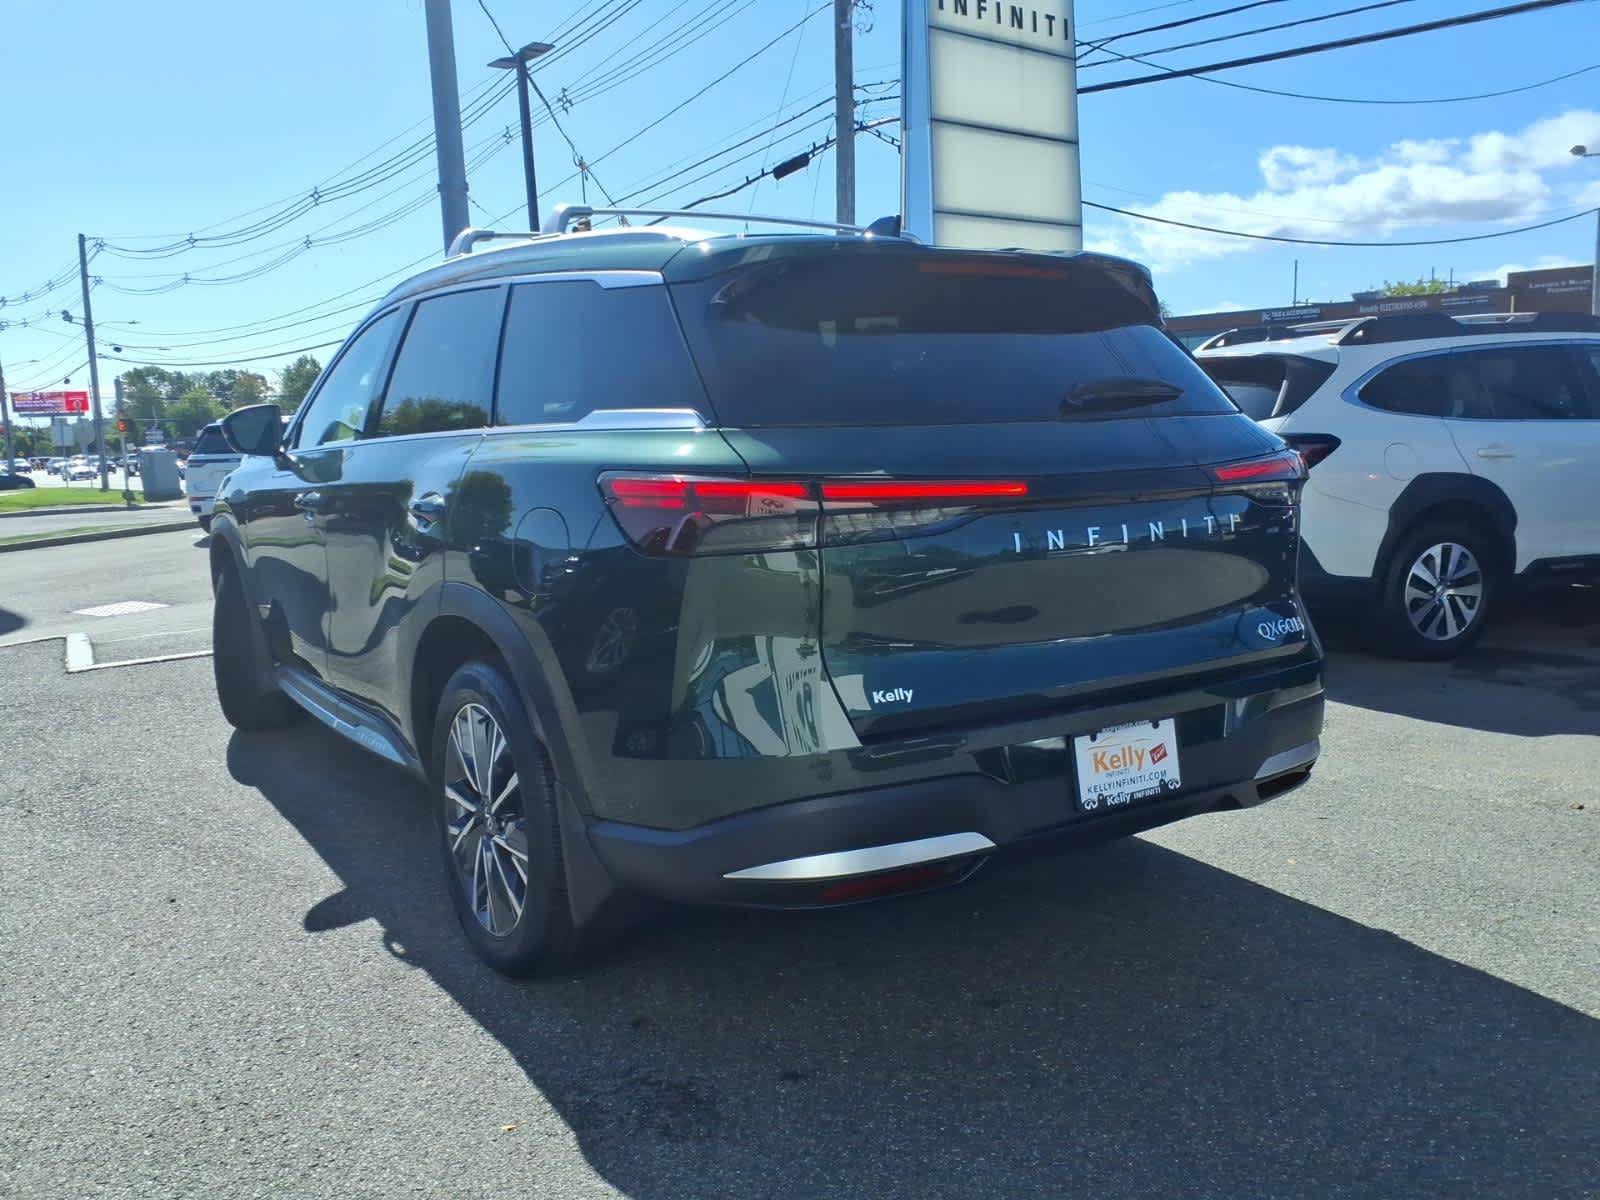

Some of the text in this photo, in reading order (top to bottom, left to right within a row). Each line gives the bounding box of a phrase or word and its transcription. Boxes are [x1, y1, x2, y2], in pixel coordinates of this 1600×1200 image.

[1013, 513, 1237, 553] INFINITI
[872, 688, 913, 704] Kelly
[1093, 745, 1145, 773] Kelly
[1087, 769, 1168, 795] KELLYINFINITI.COM
[1106, 792, 1132, 806] Kelly
